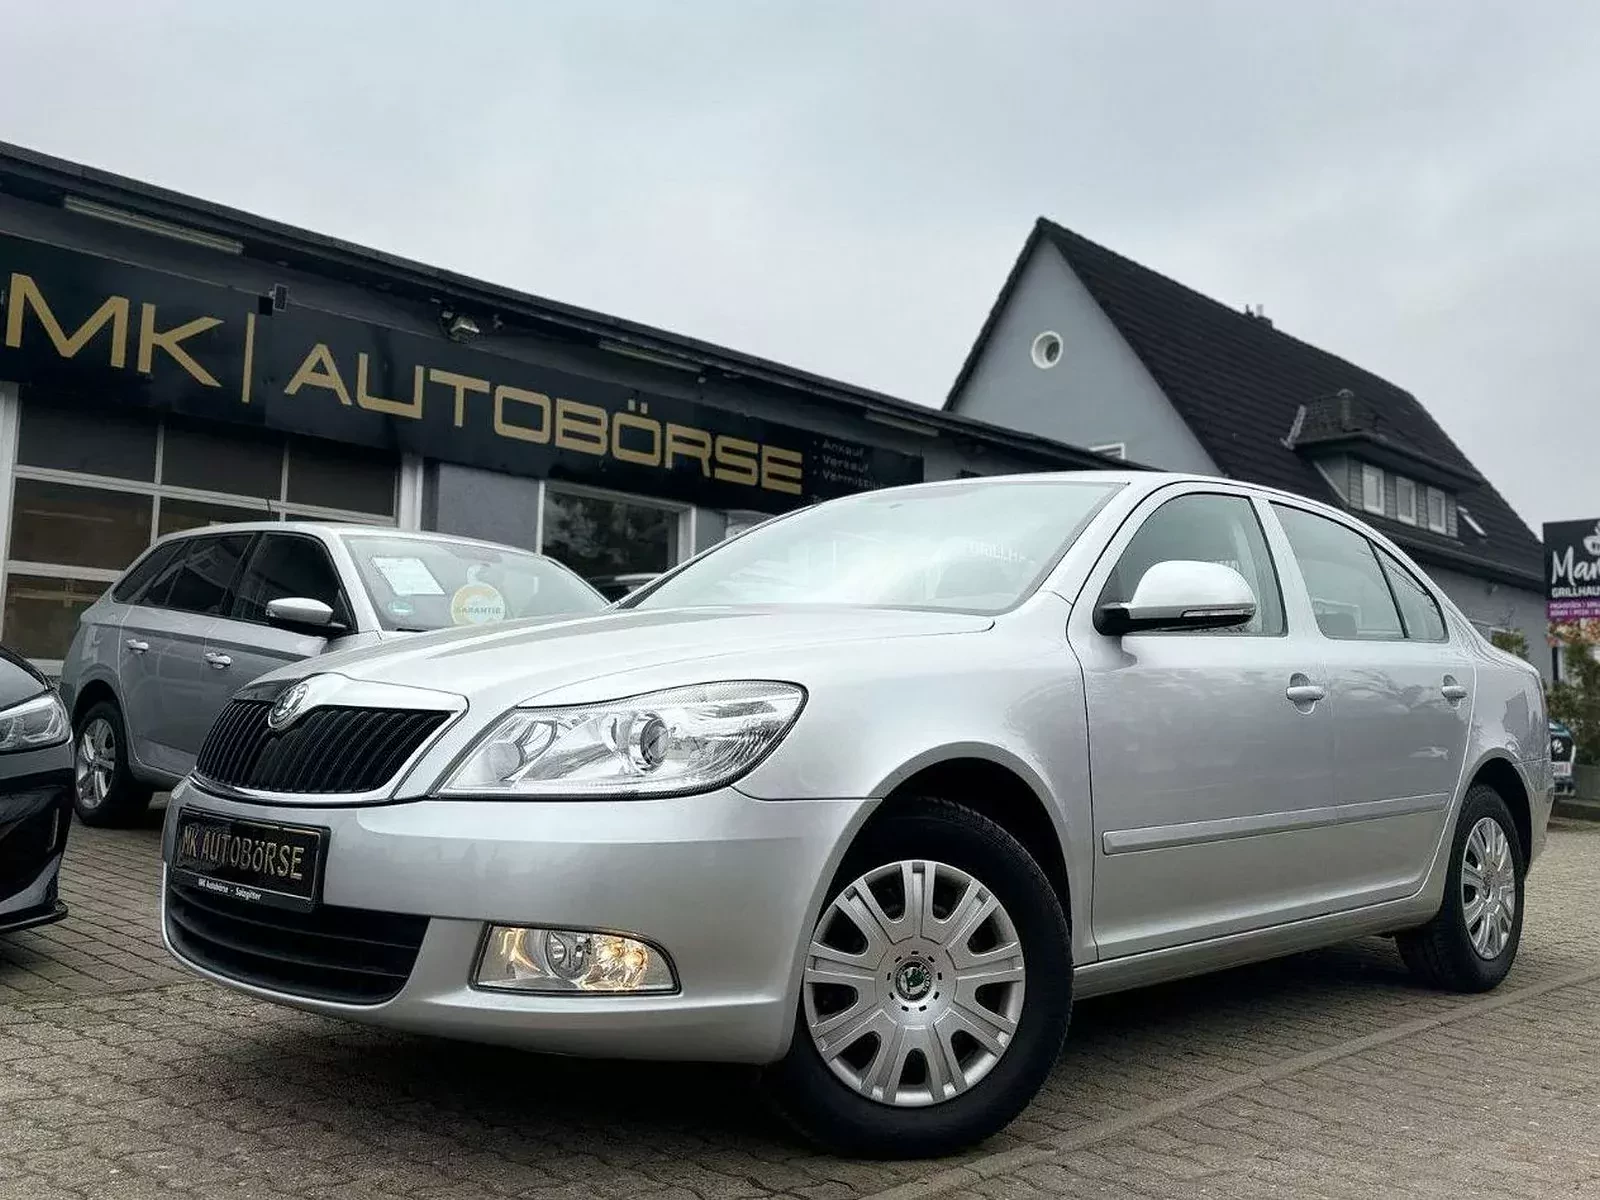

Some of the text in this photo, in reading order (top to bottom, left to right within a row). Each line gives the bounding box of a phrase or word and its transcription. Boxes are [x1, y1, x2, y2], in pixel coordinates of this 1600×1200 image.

[6, 272, 803, 494] MK AUTOBÖRSE
[822, 439, 864, 457] Ankauf
[200, 830, 304, 881] AUTOBÖRSE
